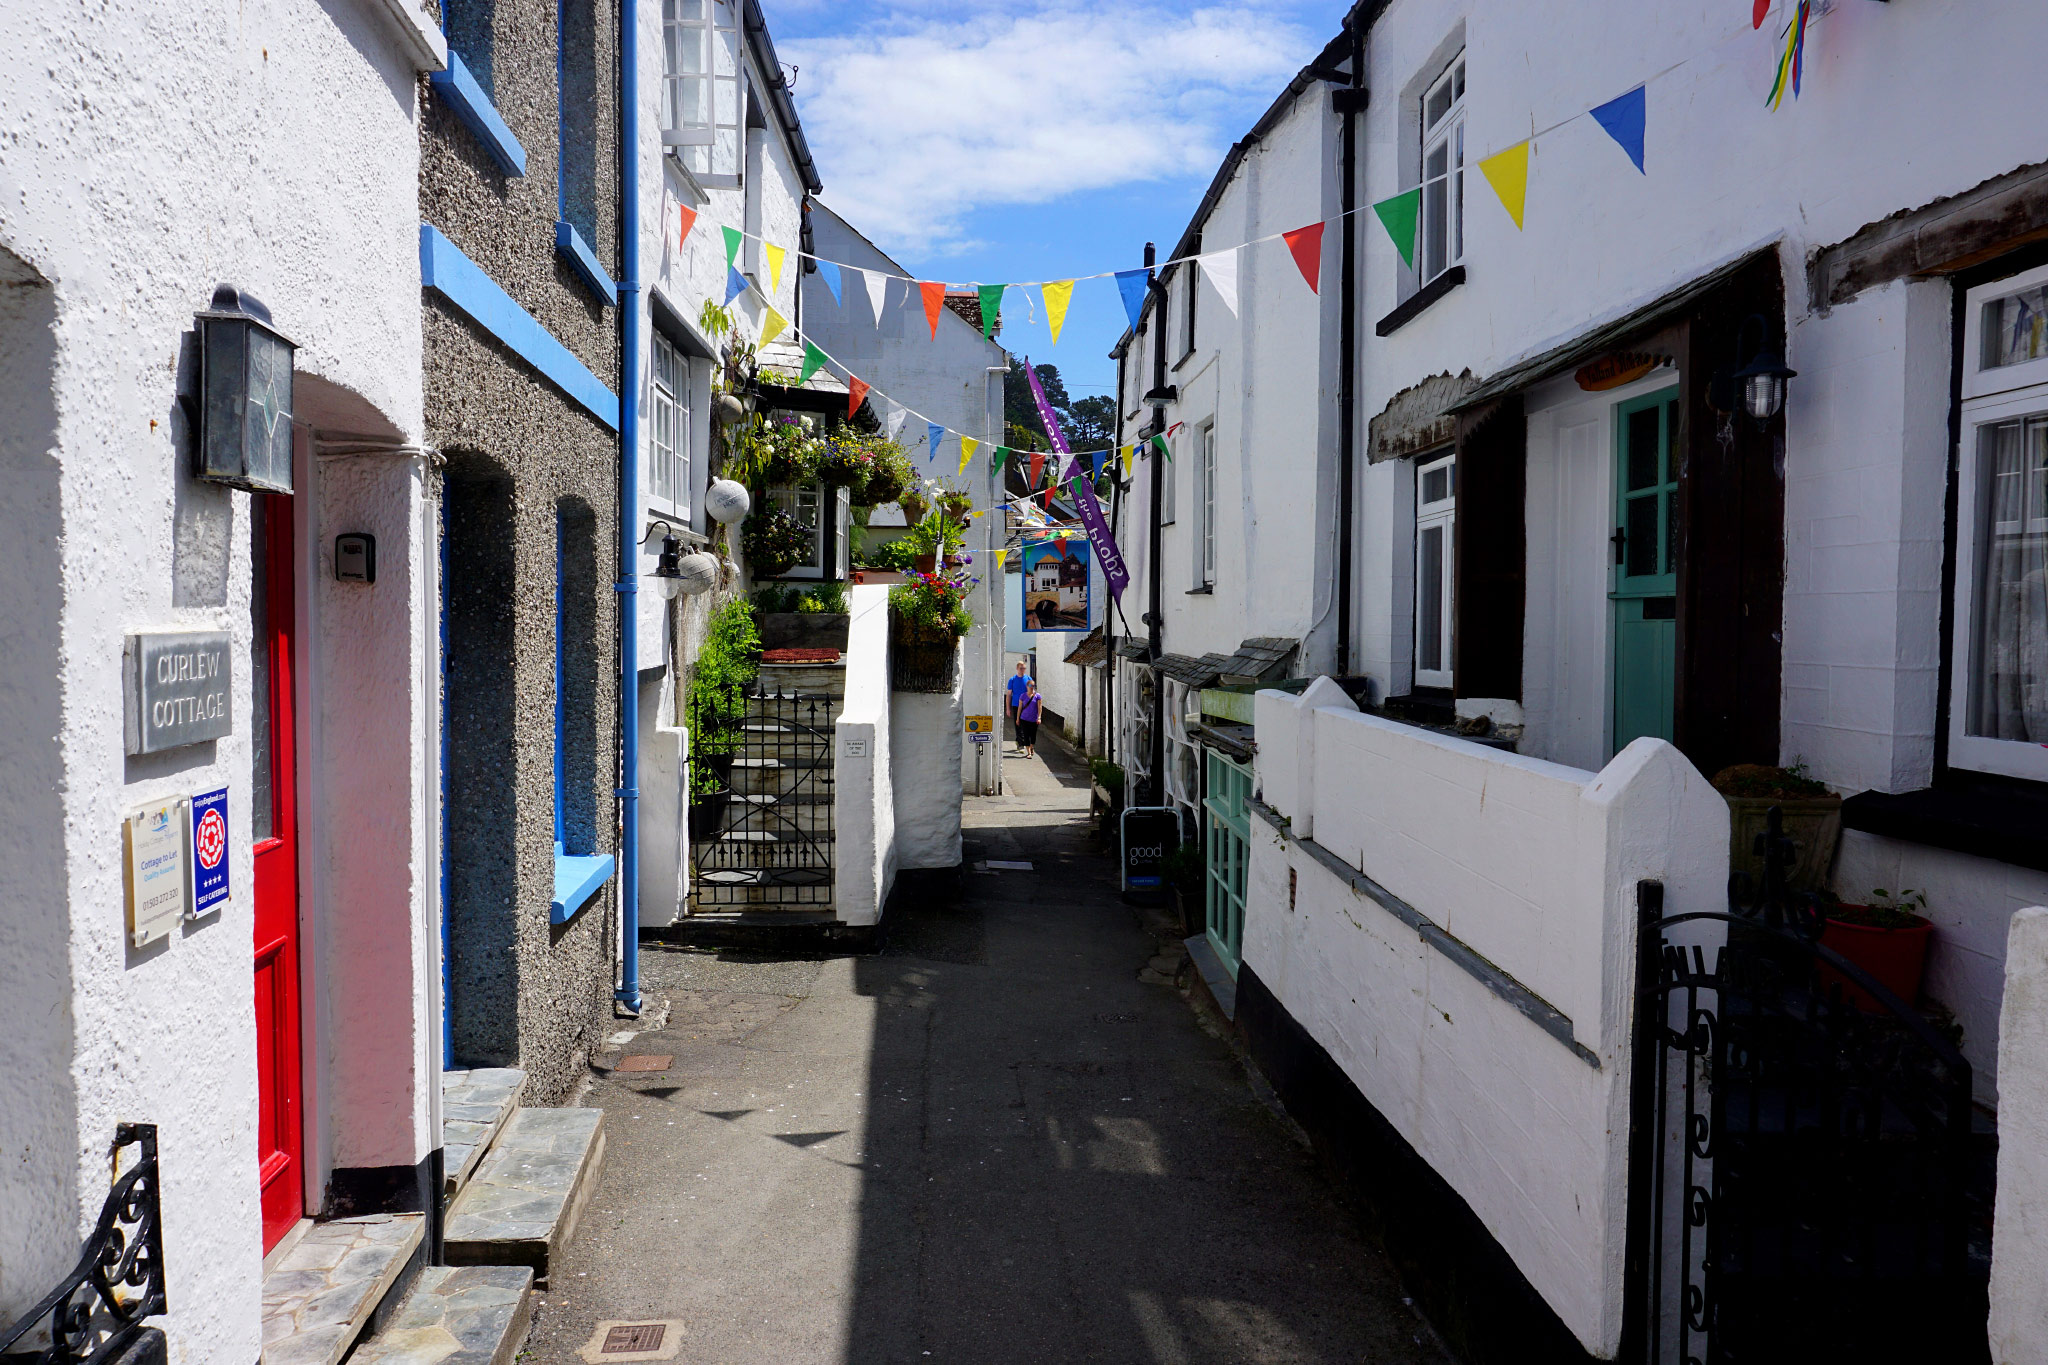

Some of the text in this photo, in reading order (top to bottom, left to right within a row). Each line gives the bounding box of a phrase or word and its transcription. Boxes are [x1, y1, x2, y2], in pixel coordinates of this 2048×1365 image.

[157, 652, 220, 684] CURLEW
[152, 692, 225, 728] COTTAGE
[194, 793, 226, 808] enjoyEngland.com
[140, 849, 178, 871] Cottage to Let
[1130, 842, 1162, 866] good
[159, 891, 169, 905] 272
[168, 887, 179, 902] 320
[198, 885, 228, 905] SELF CATERING
